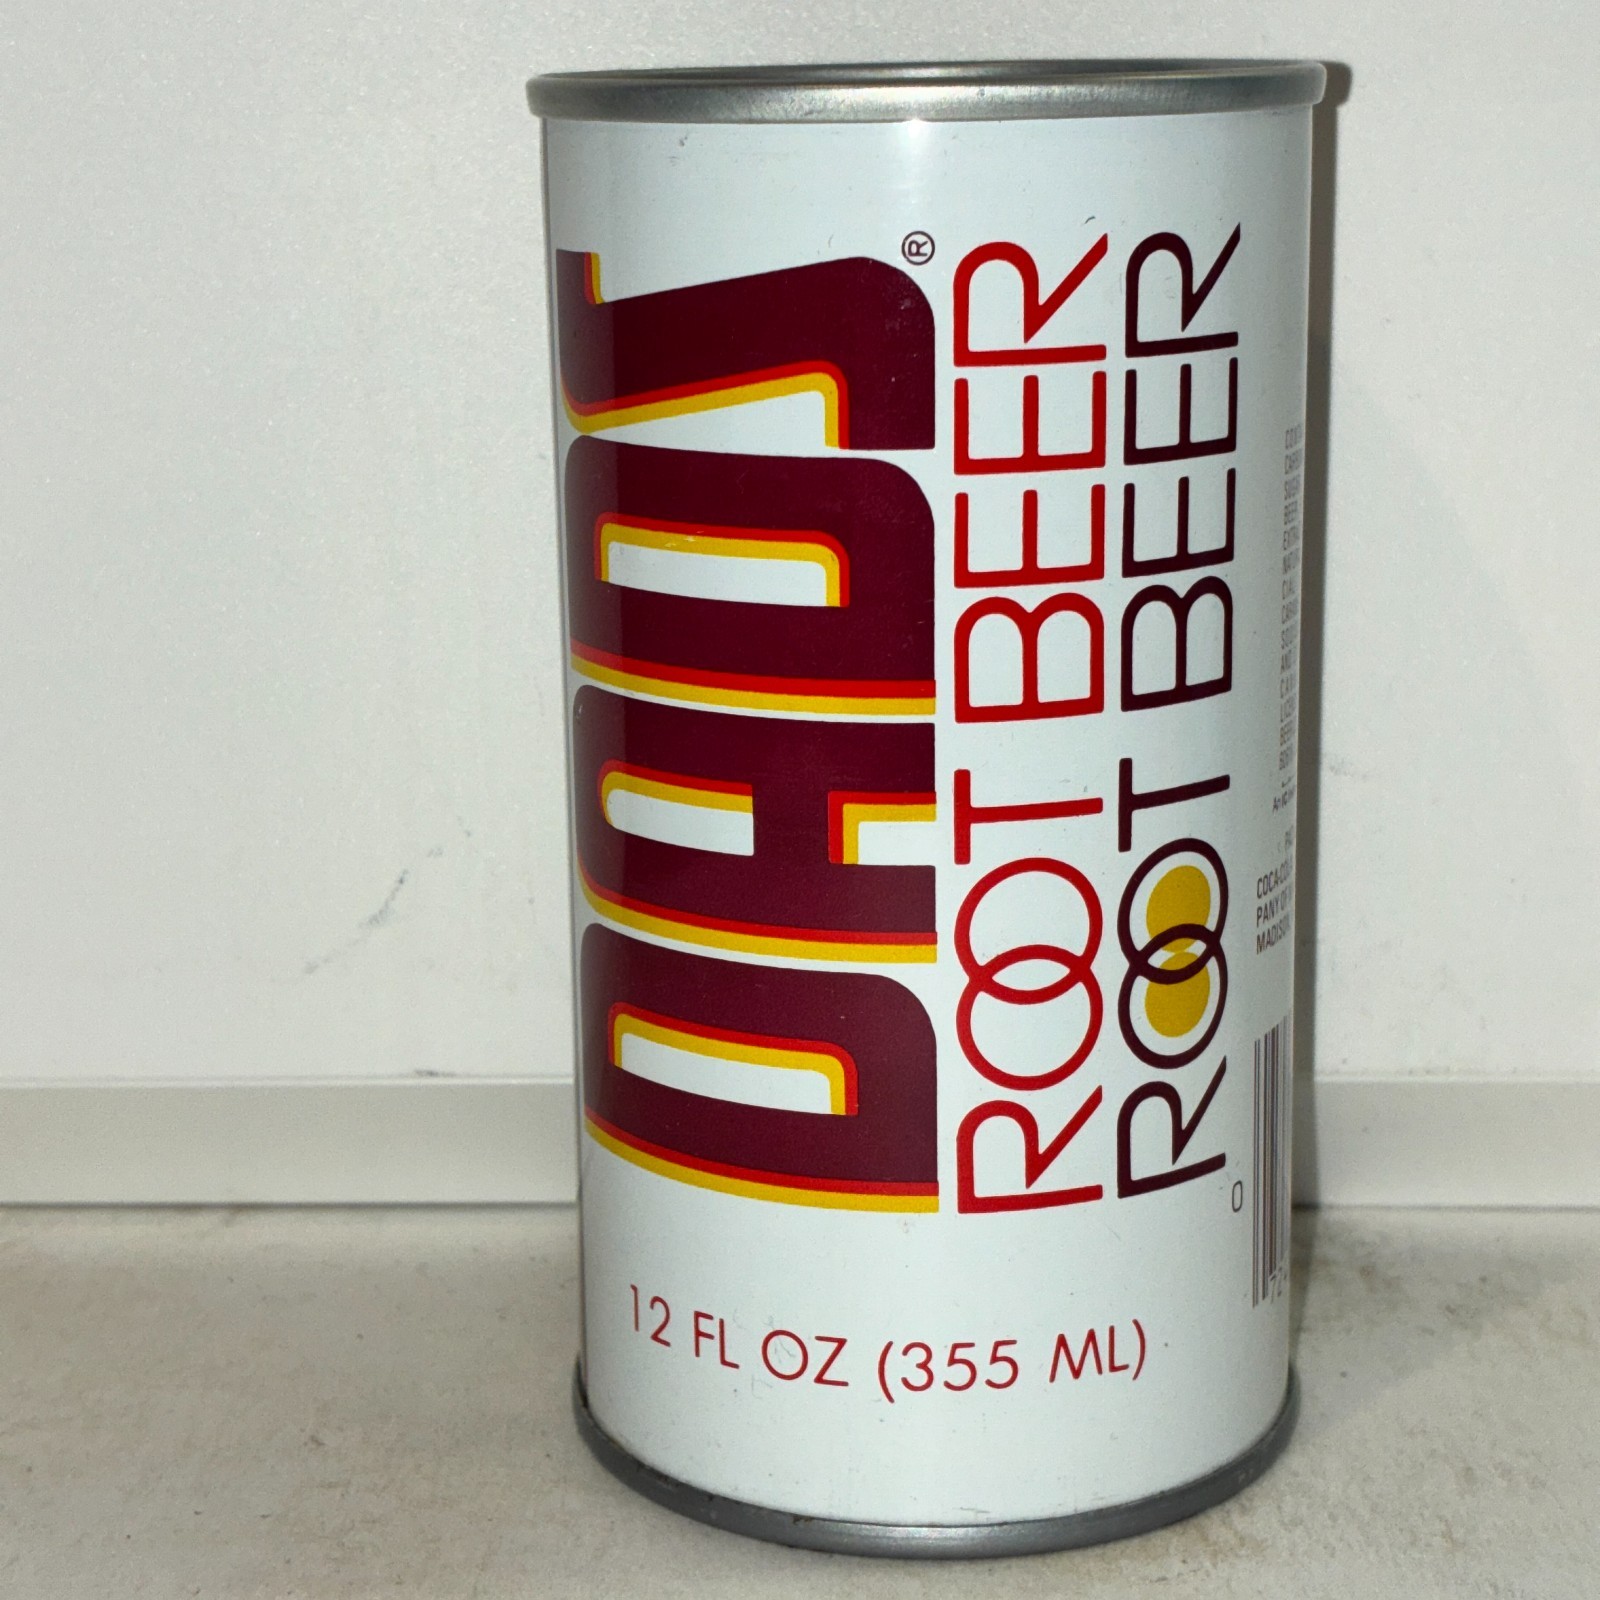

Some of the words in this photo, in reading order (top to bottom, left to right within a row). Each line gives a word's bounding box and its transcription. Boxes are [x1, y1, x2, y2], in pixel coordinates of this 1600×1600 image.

[953, 233, 1108, 723] BEER
[1120, 222, 1241, 711] BEER
[556, 249, 938, 1214] DADS
[953, 769, 1104, 1214] ROOT
[1118, 757, 1231, 1200] ROOT
[630, 1284, 671, 1347] 12
[693, 1310, 740, 1369] FL
[760, 1328, 850, 1387] OZ
[877, 1340, 1020, 1404] (355
[1048, 1318, 1147, 1384] ML)
